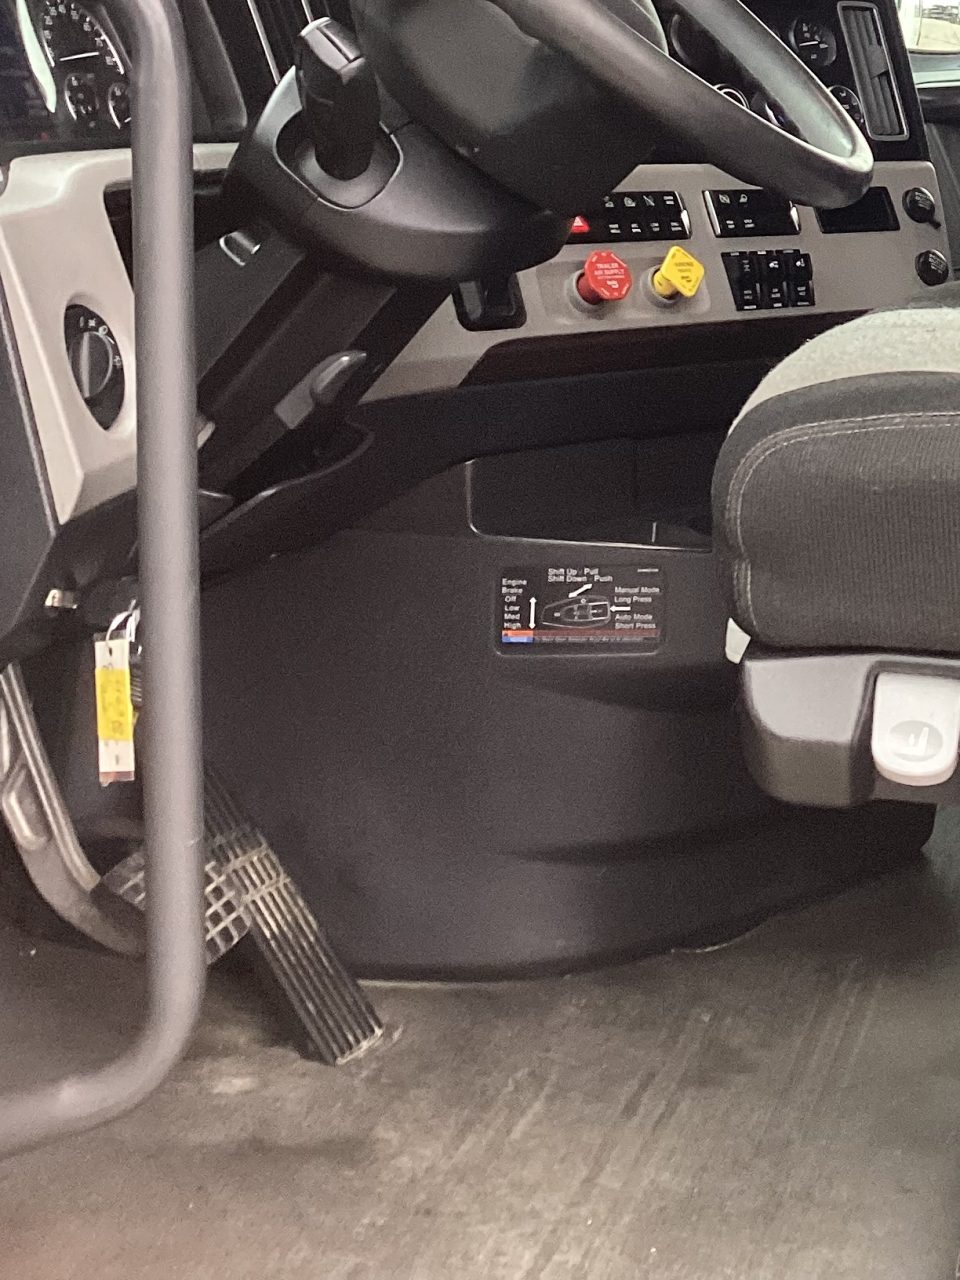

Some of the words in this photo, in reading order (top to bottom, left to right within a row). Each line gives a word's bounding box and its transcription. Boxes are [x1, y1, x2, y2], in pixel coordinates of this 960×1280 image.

[548, 568, 565, 576] Shift
[566, 568, 577, 577] Up
[583, 567, 599, 576] Pull
[502, 578, 527, 587] Engine
[547, 575, 565, 583] Shift
[614, 586, 639, 594] Manual
[640, 586, 660, 594] Mode
[504, 595, 517, 603] Off
[614, 596, 631, 604] Long
[504, 604, 520, 612] Low
[614, 613, 632, 621] Auto
[633, 613, 653, 621] Mode
[504, 622, 522, 630] High
[614, 622, 636, 630] Short
[636, 622, 656, 630] Press
